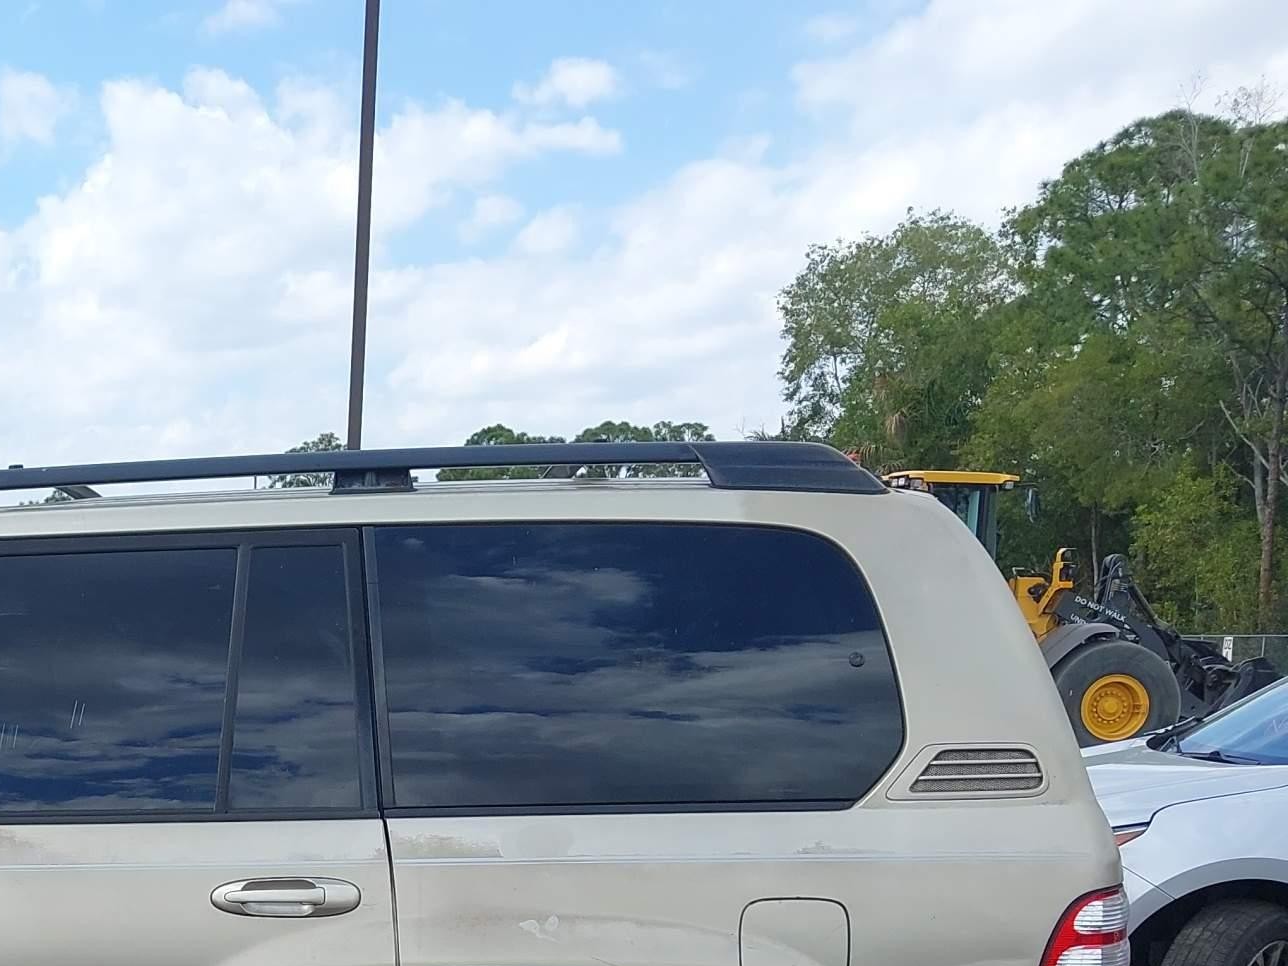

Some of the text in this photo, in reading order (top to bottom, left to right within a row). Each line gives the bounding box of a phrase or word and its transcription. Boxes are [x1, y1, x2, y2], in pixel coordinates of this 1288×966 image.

[1074, 595, 1127, 623] DO NOT WALK
